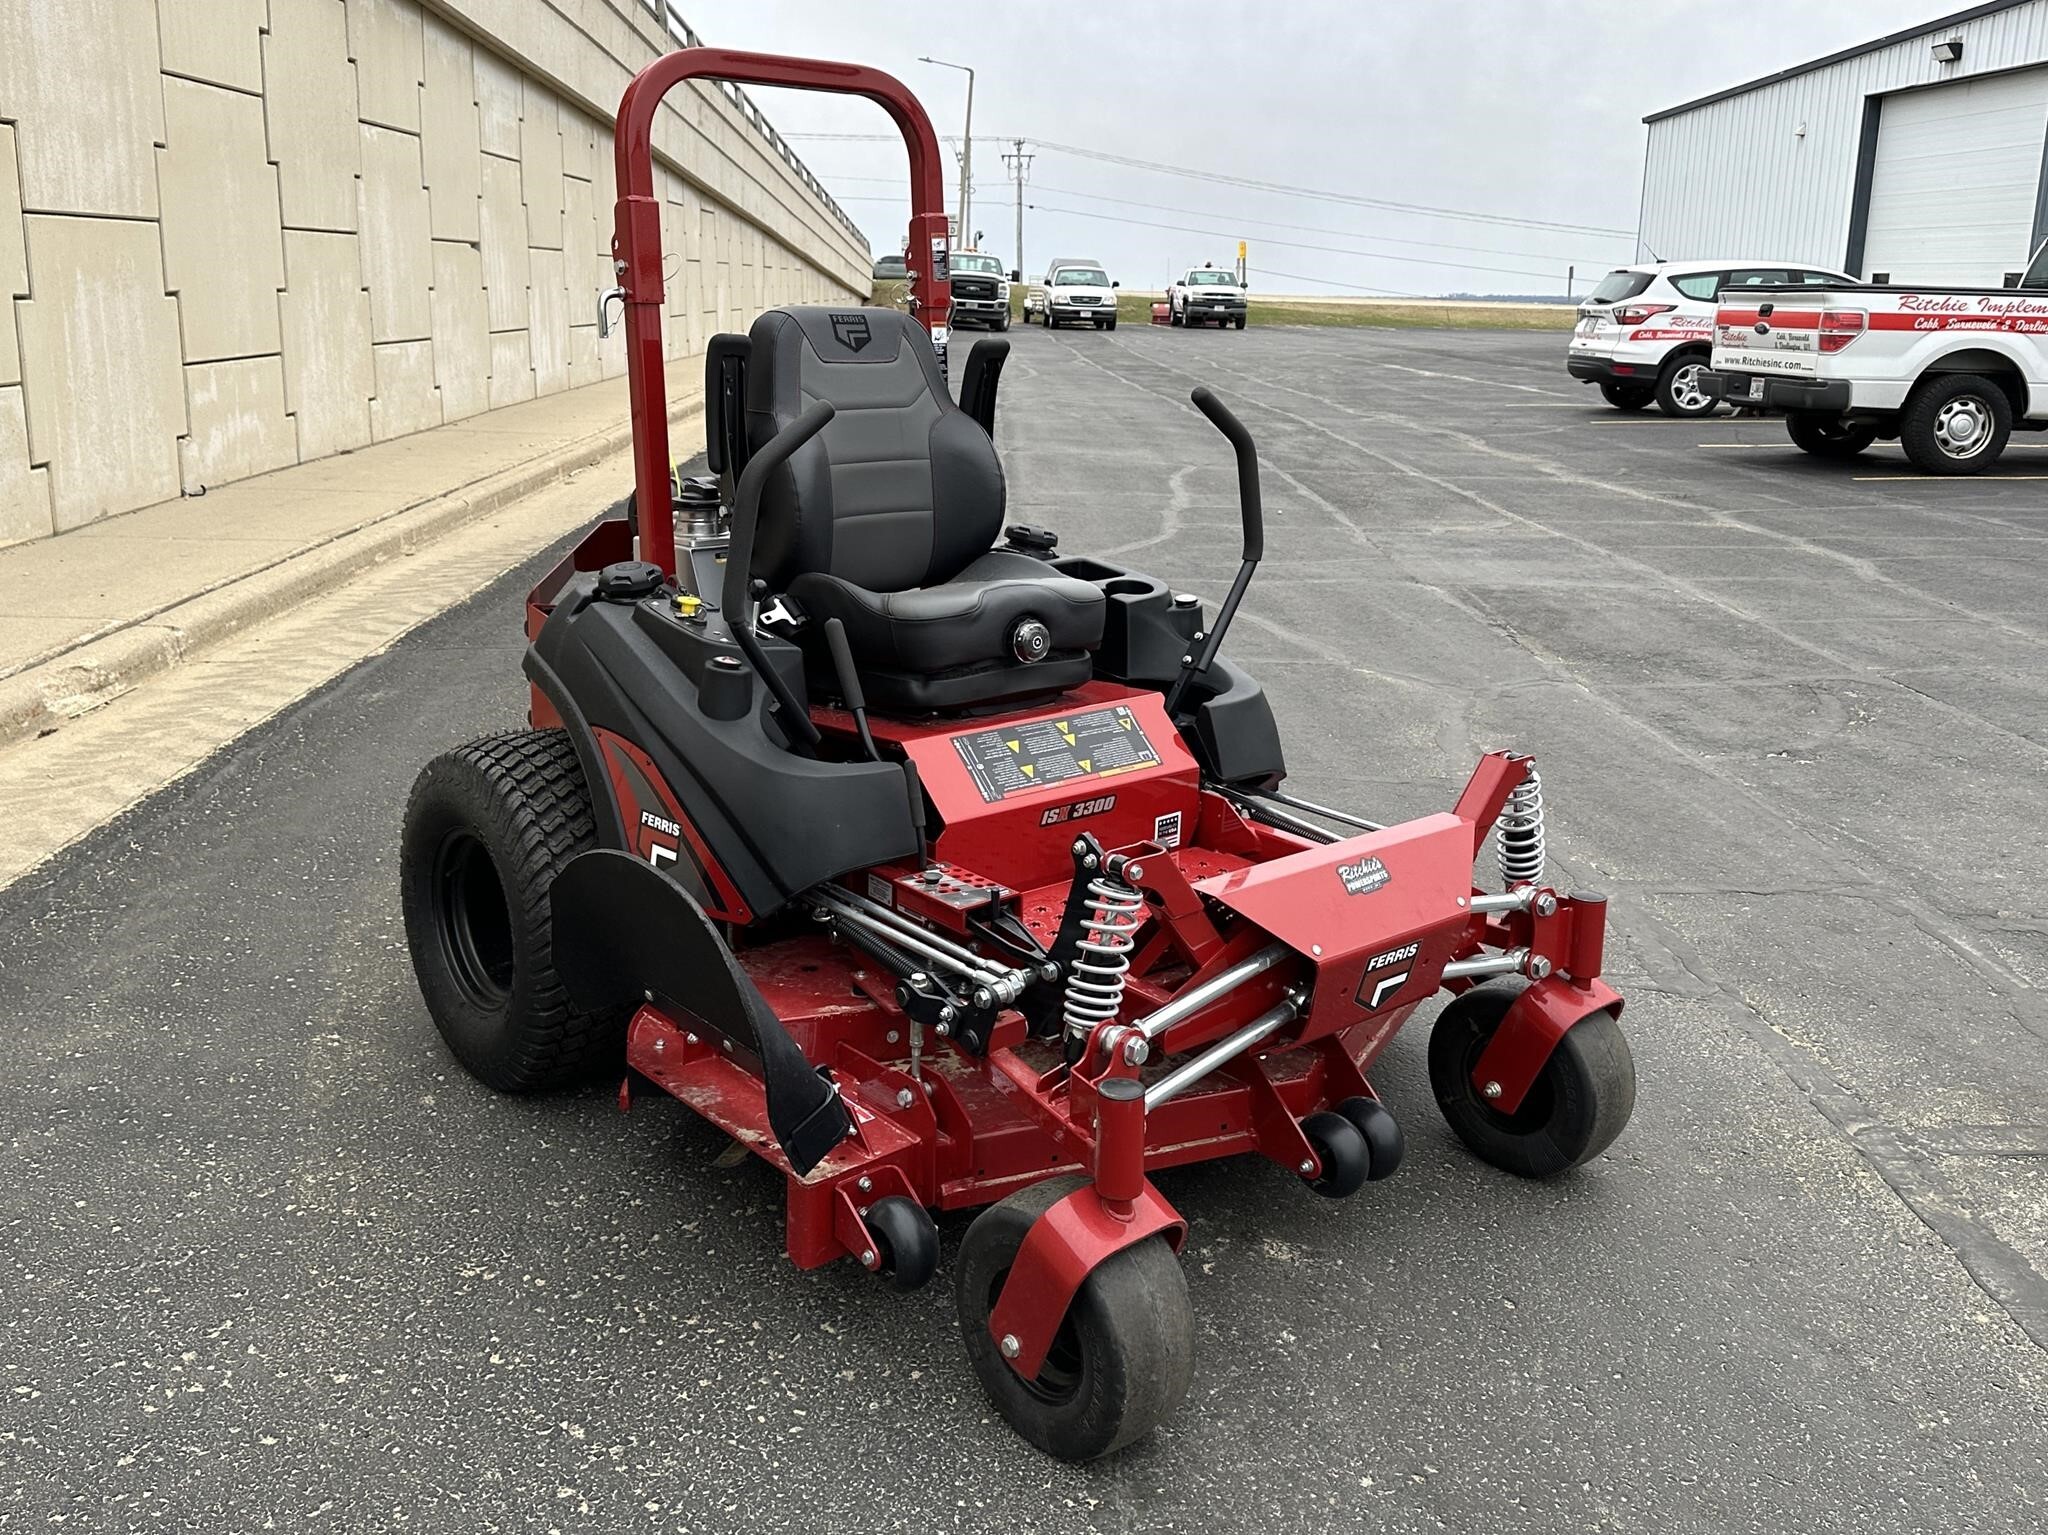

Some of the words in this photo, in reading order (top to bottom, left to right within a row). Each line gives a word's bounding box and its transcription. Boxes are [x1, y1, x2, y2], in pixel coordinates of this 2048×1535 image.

[1898, 295, 1969, 312] Ritchie
[832, 315, 864, 323] FERRIS
[2001, 320, 2011, 331] &
[1724, 356, 1802, 370] www.Ritchiesinc.com
[1041, 805, 1072, 825] ISX
[1072, 796, 1116, 818] 3300
[641, 811, 680, 837] FERRIS
[1367, 943, 1418, 972] FERRIS
